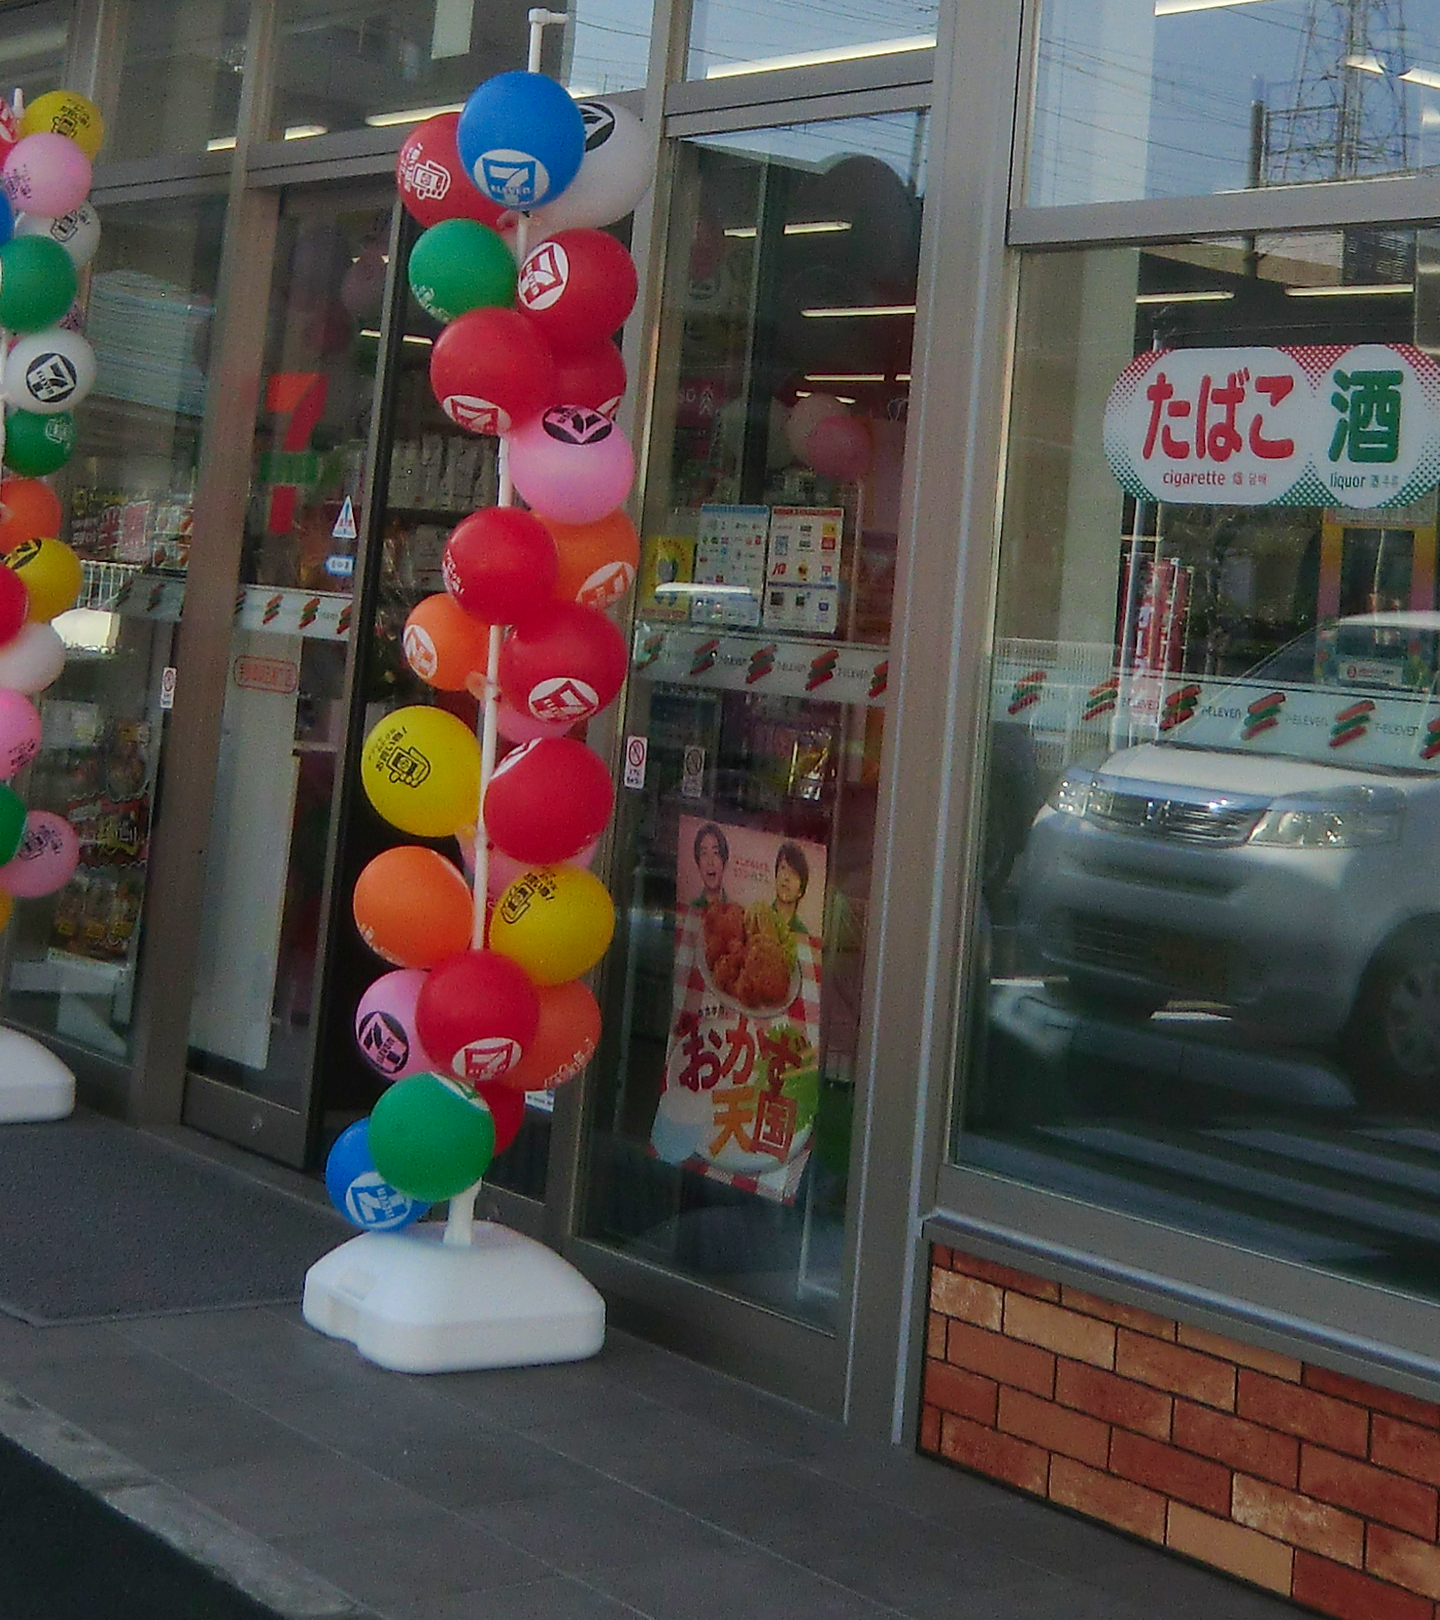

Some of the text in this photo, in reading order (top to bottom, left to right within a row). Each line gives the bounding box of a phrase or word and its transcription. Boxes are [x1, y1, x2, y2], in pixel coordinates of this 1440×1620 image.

[1142, 366, 1295, 462] たばこ
[1327, 368, 1405, 464] 酒
[1163, 470, 1226, 487] cigarette
[1329, 471, 1366, 491] liquor
[709, 1086, 798, 1164] 天国
